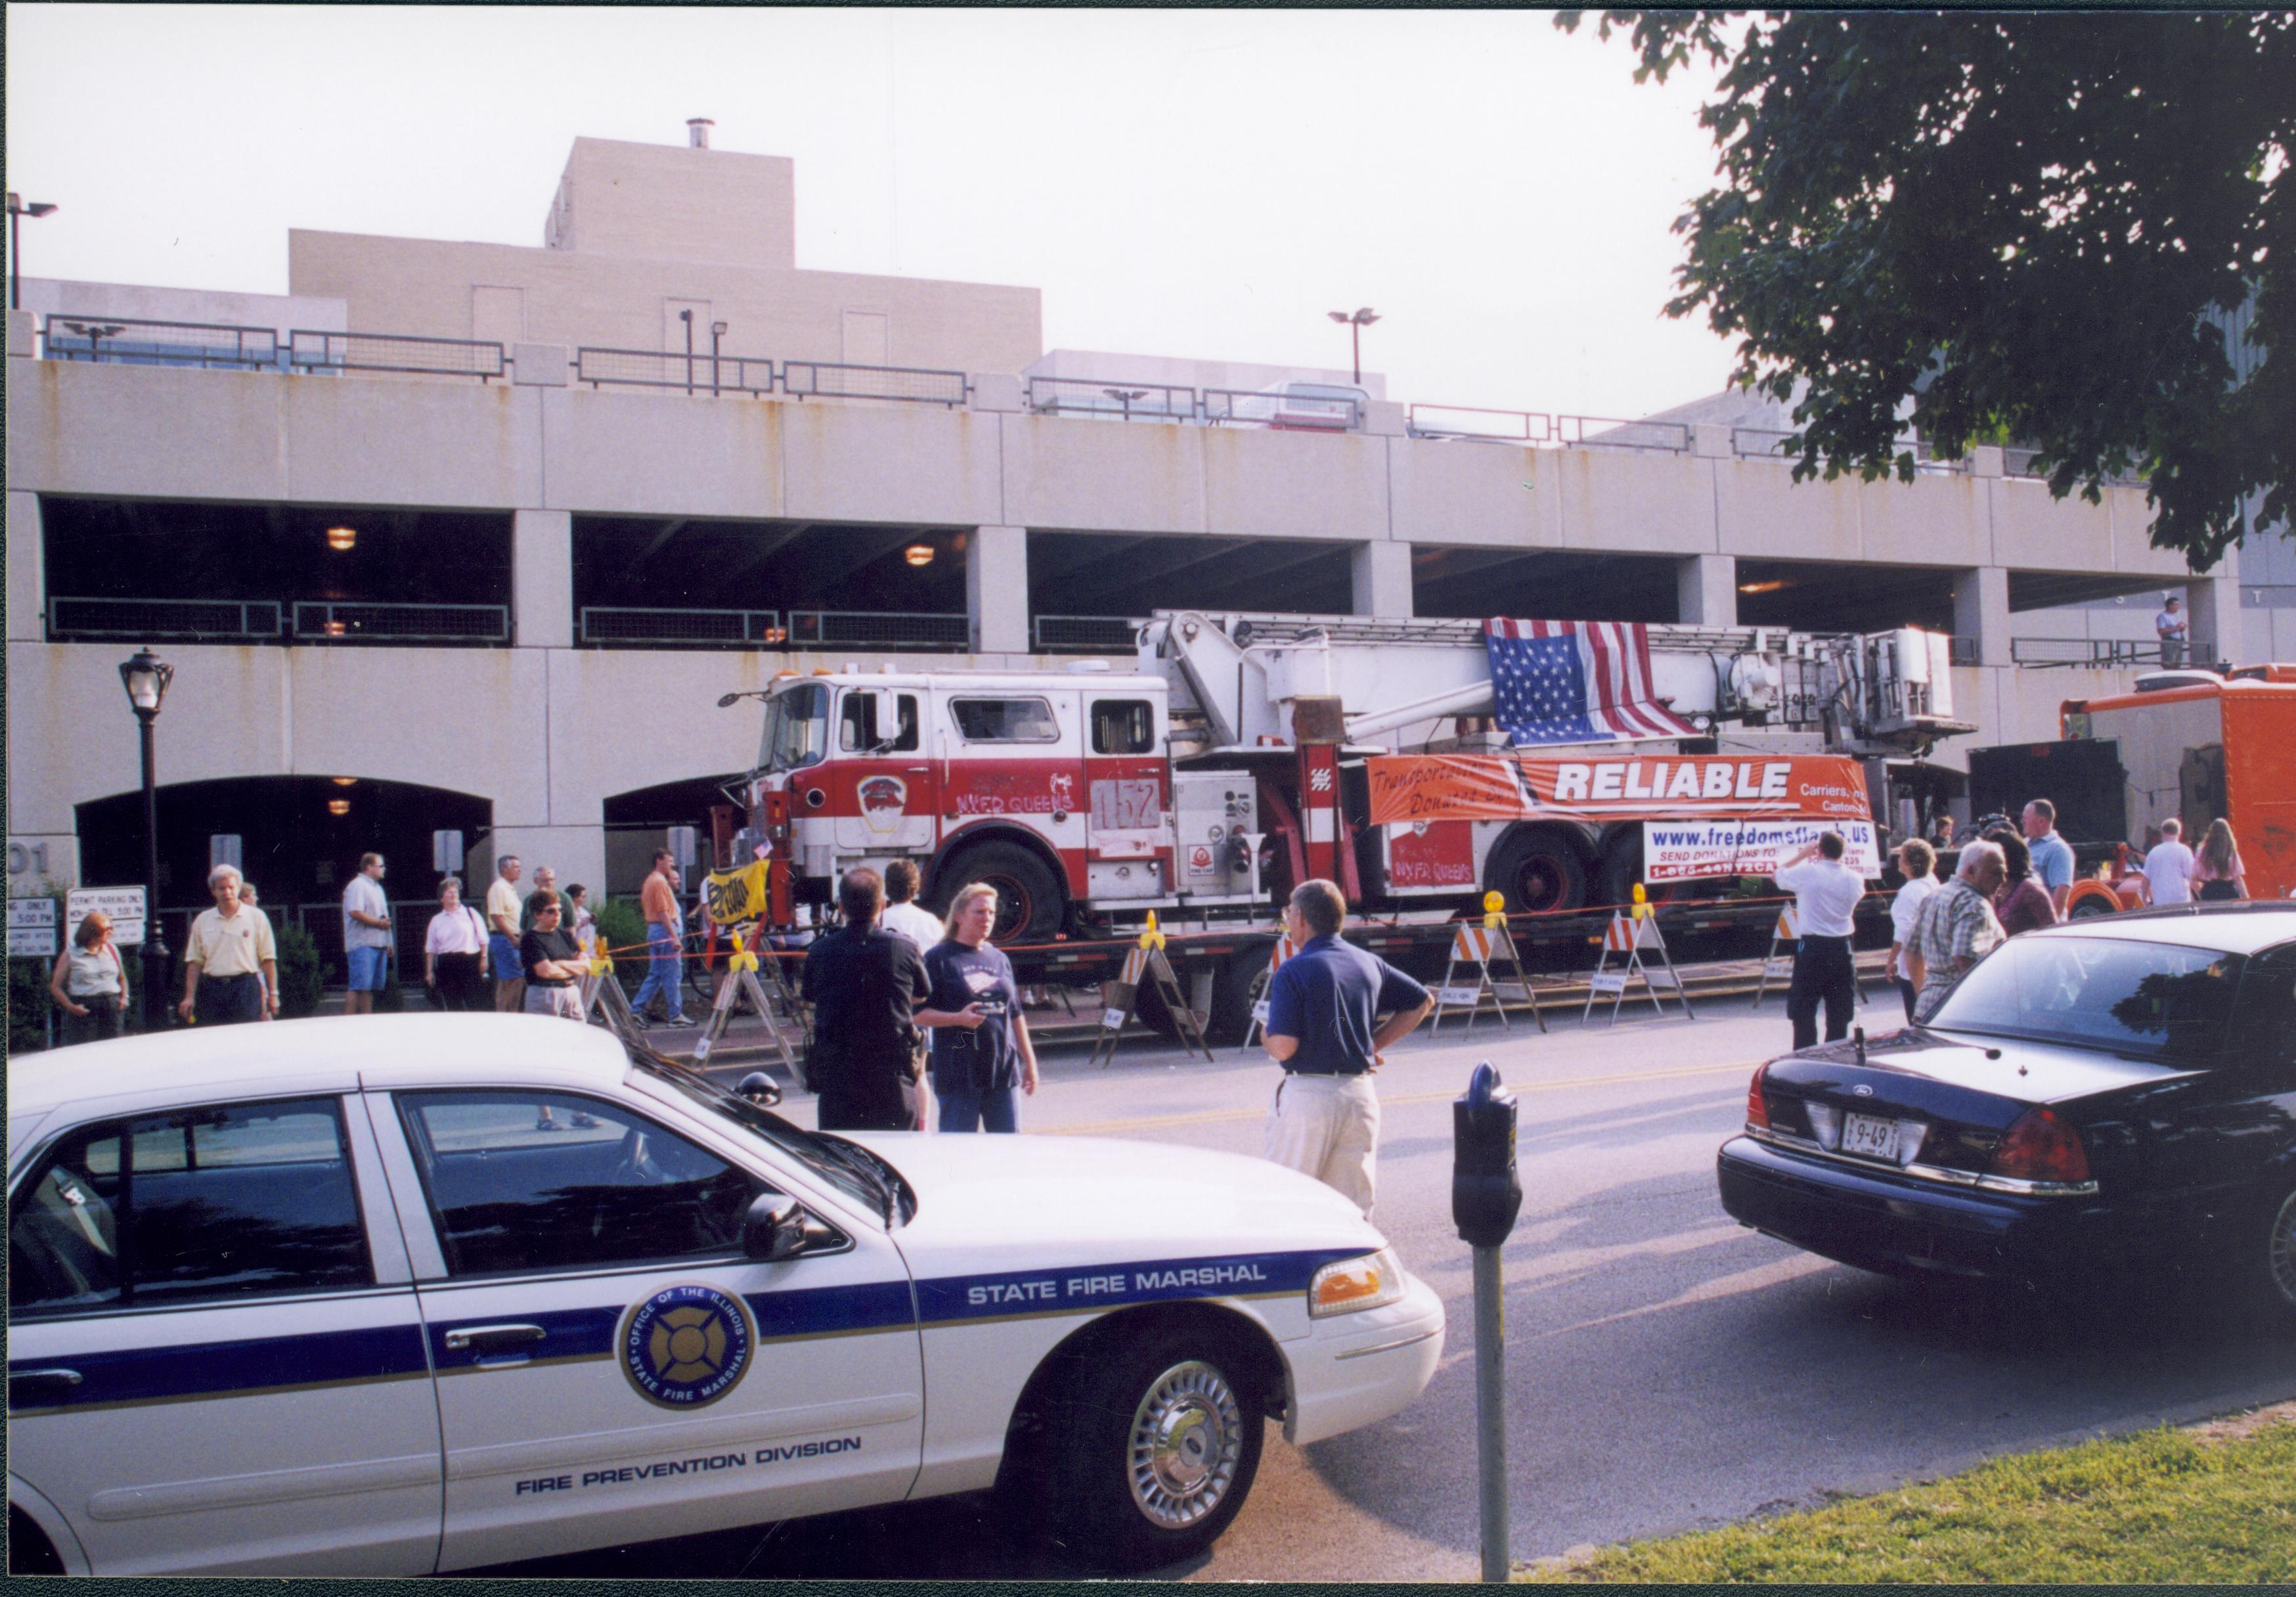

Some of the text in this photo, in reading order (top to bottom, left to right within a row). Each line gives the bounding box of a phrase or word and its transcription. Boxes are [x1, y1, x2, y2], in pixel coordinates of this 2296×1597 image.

[1553, 762, 1791, 801] RELIABLE
[1800, 783, 1849, 798] Carriers,
[1009, 795, 1074, 814] QUEENS
[1660, 851, 1690, 862] SEND
[1693, 848, 1757, 861] DONATIONS
[1433, 862, 1472, 882] QUEENS
[27, 901, 48, 911] ONLY
[70, 895, 143, 905] PERMIT PARKING ONLY
[18, 913, 53, 924] 5:00 PM
[1857, 1123, 1887, 1148] 9-49
[968, 1264, 1266, 1305] STATE FIRE MARSHAL
[630, 1286, 745, 1345] OFFICE OF THE ILLINOIS
[630, 1347, 747, 1401] STATE FIRE MARSHAL
[515, 1437, 862, 1495] FIRE PREVENTION DIVISION
